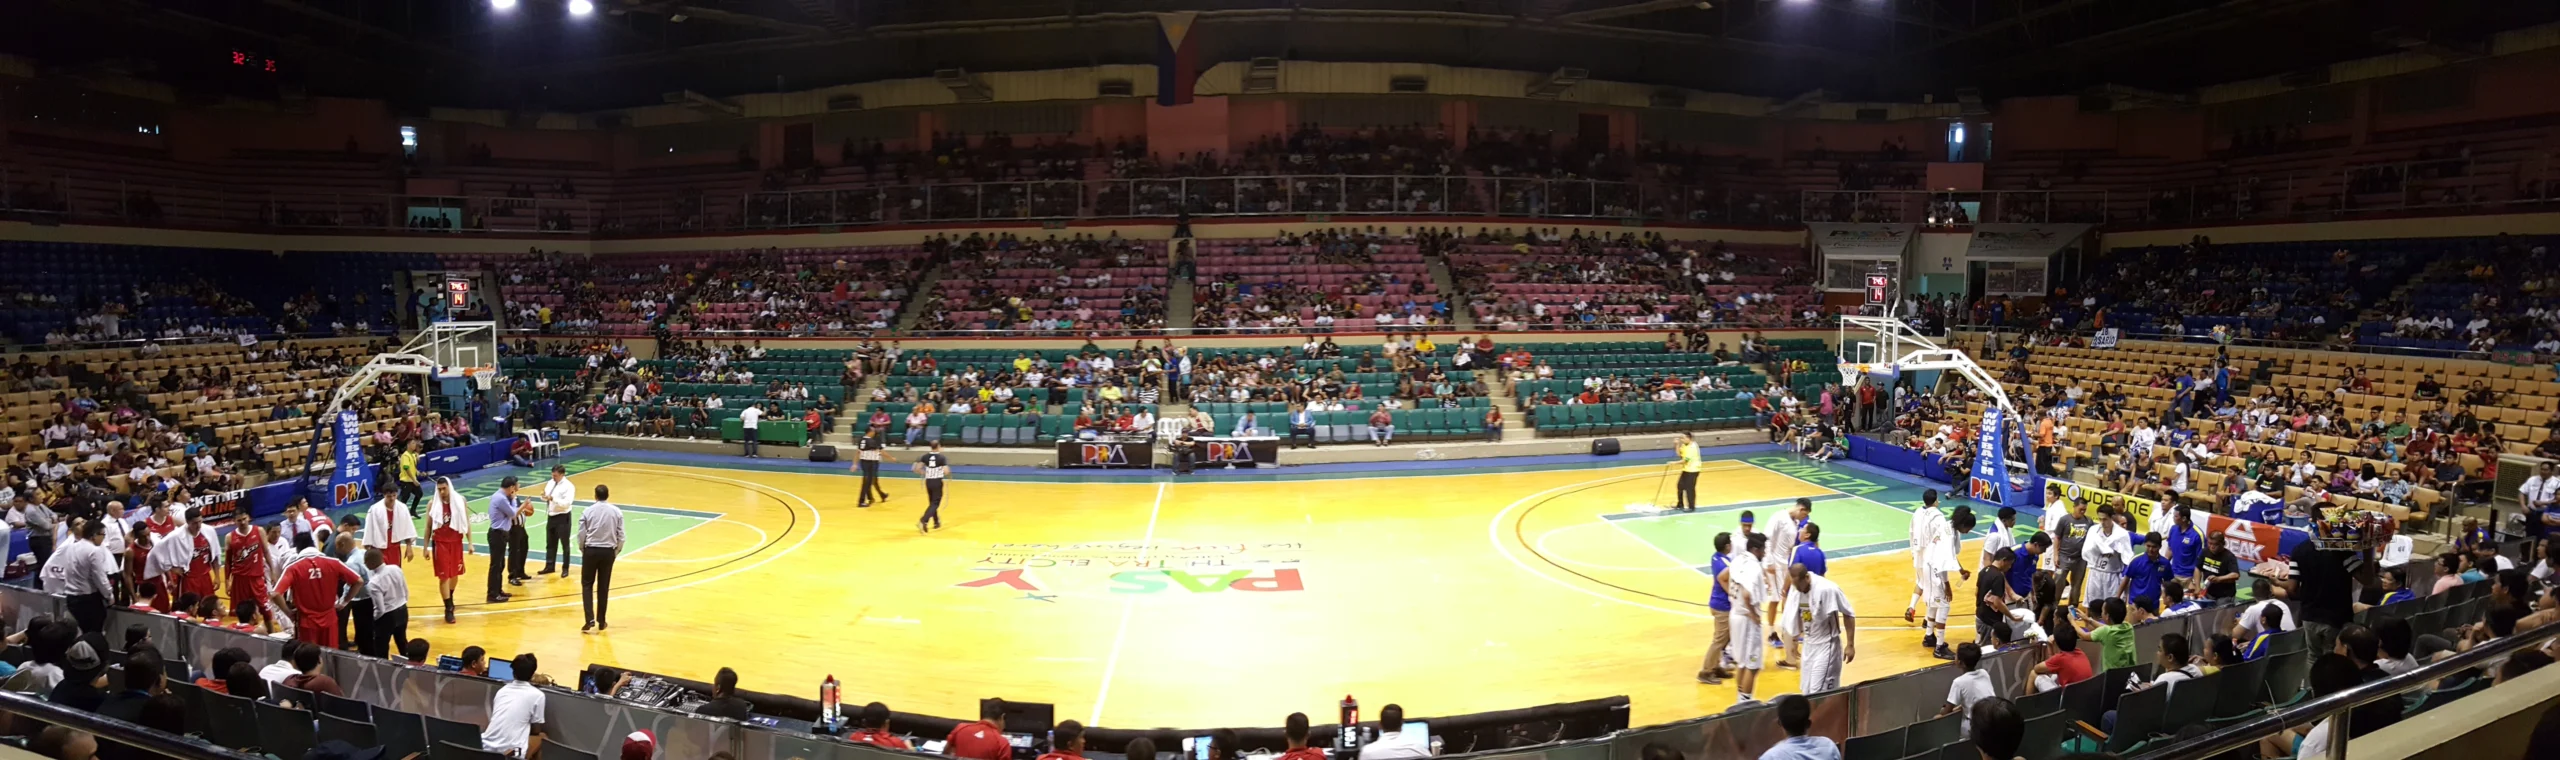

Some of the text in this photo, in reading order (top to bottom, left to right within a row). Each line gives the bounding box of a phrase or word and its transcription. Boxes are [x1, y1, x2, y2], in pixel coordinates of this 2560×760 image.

[1081, 443, 1128, 465] PBA
[1207, 442, 1254, 463] PBA
[1747, 456, 1888, 495] CUNETA
[335, 478, 372, 507] PBA
[1970, 476, 2004, 506] PBA
[1060, 558, 1173, 569] TRAEL
[953, 567, 1305, 593] PASY
